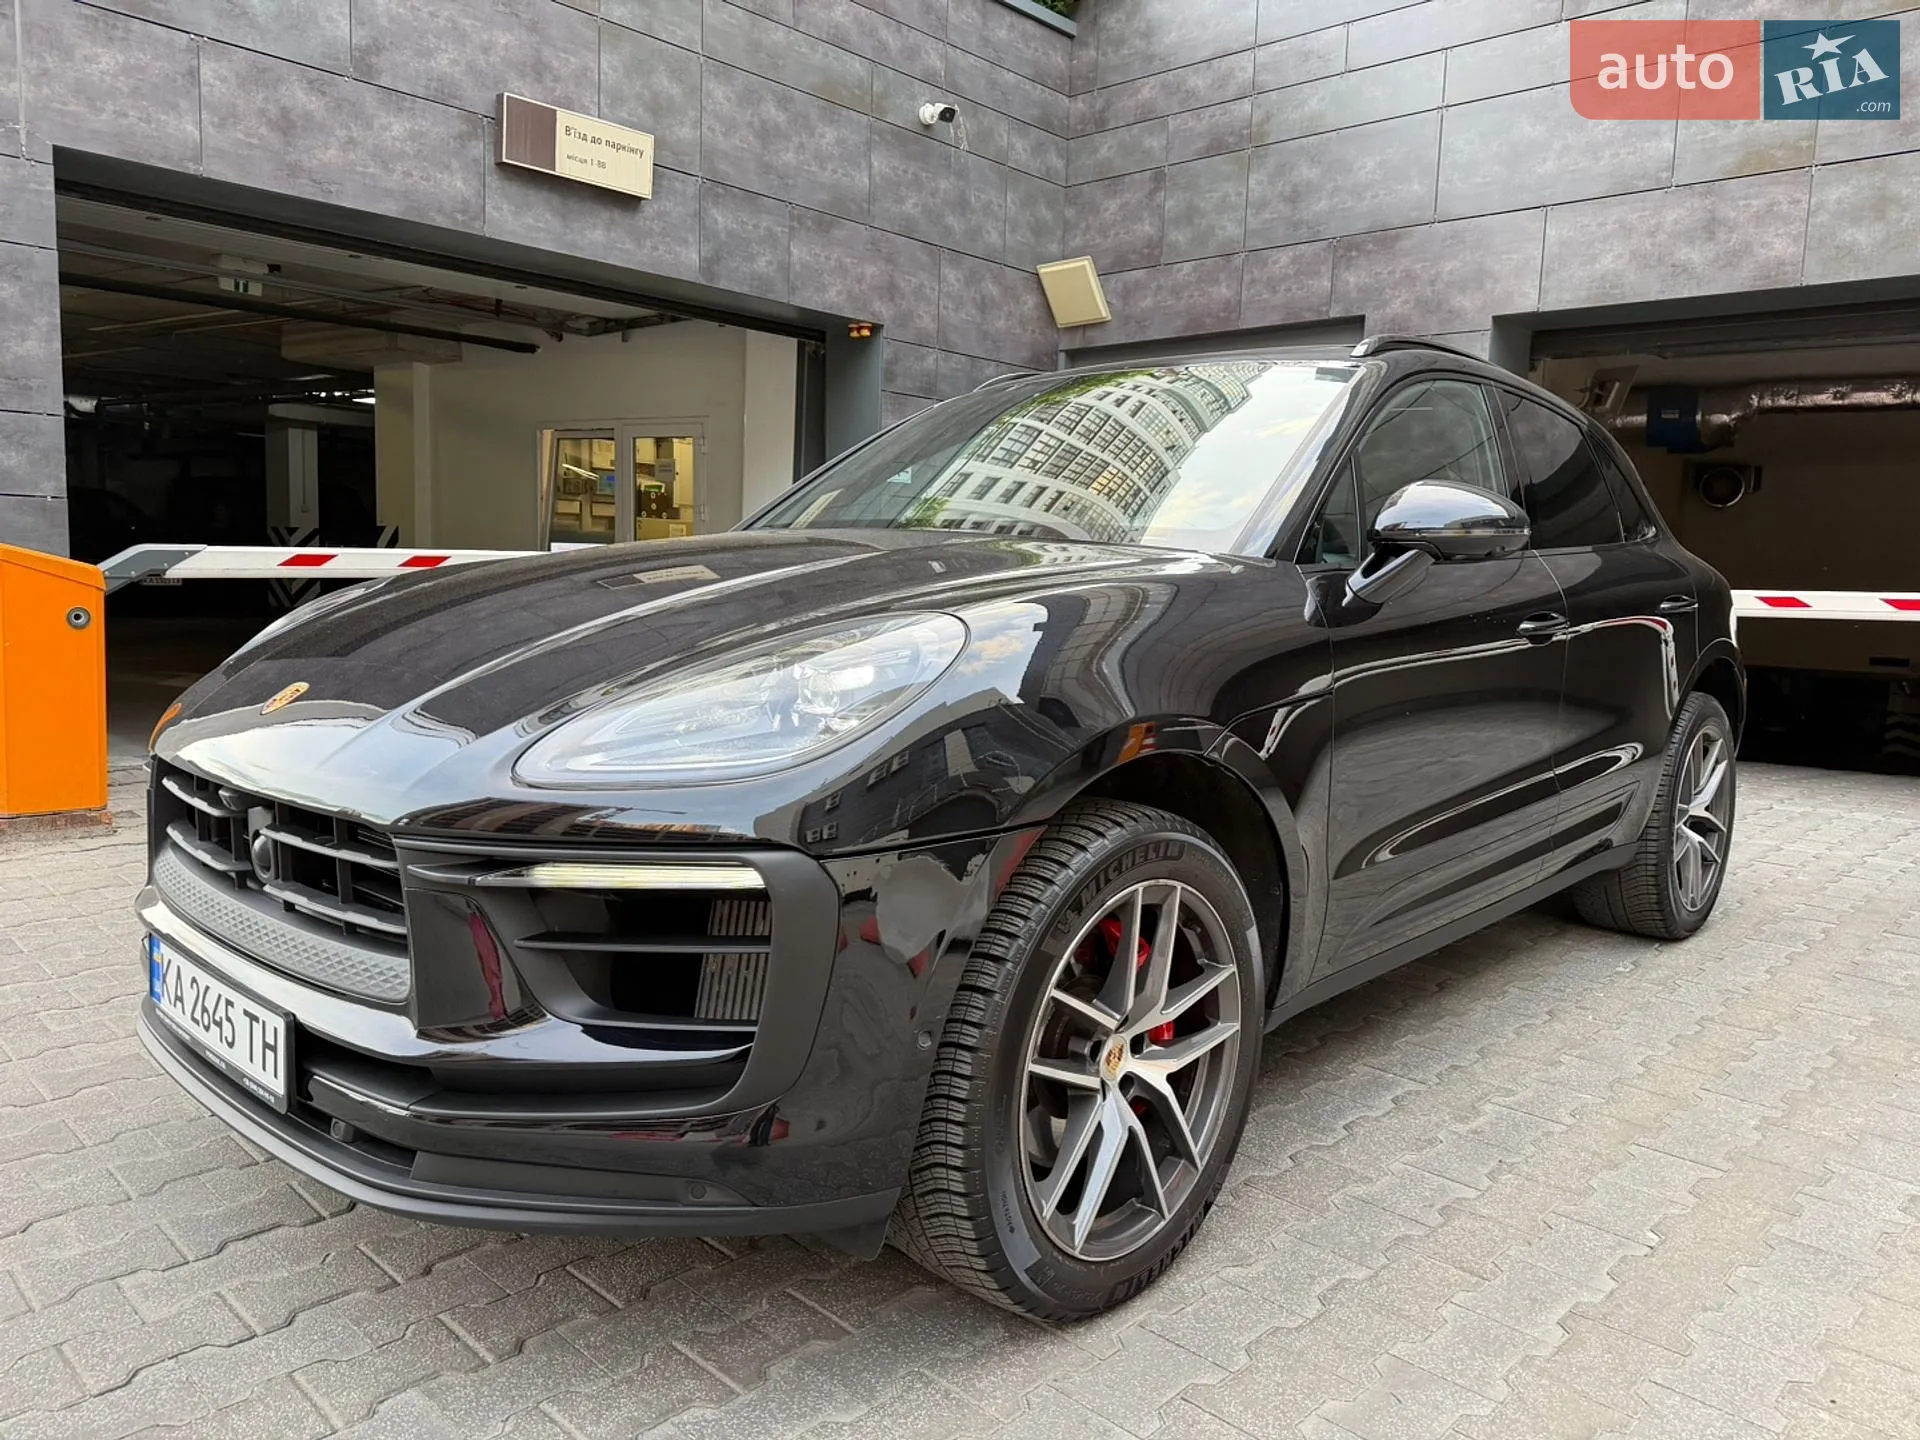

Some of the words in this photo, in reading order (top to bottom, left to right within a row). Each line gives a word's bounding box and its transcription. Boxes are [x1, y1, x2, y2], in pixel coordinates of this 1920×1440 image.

[590, 135, 603, 146] до
[605, 138, 644, 159] паркінгу
[1079, 840, 1182, 908] MICHELIN
[161, 952, 186, 1017] KA
[190, 976, 235, 1049] 2645
[243, 1008, 278, 1081] TH
